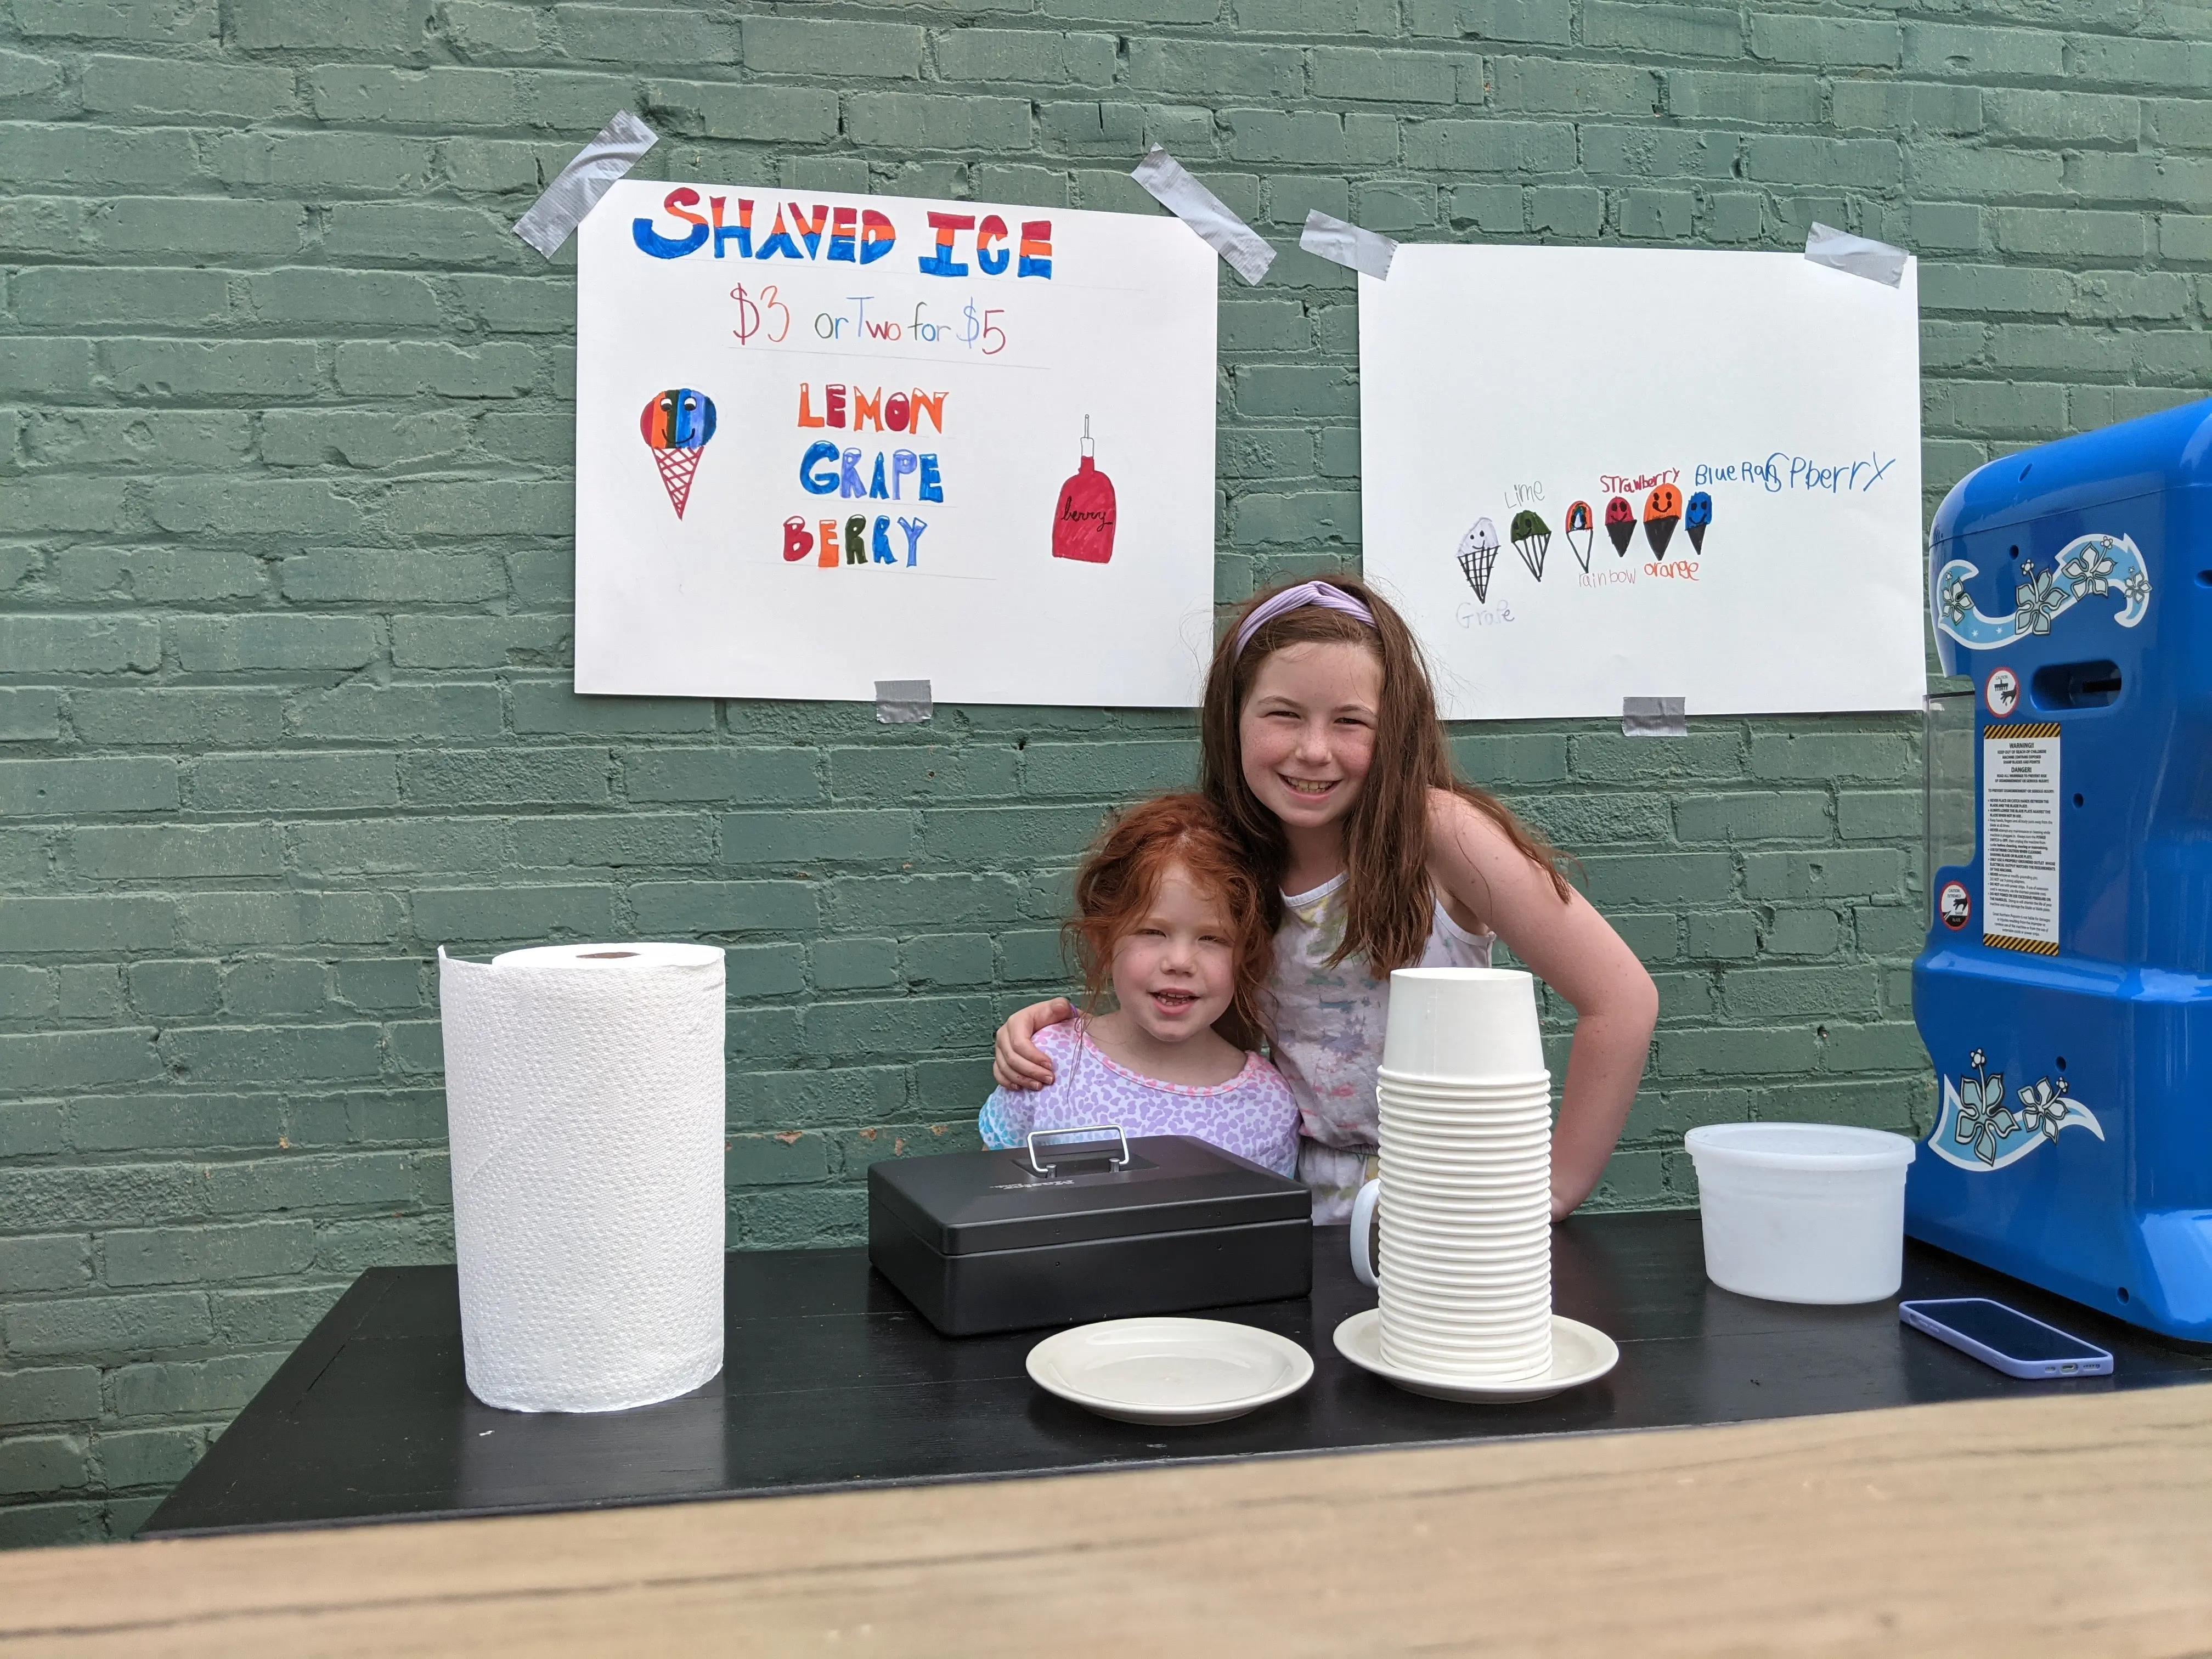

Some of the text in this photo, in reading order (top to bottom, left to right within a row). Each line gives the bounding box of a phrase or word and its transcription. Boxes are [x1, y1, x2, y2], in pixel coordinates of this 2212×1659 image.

[633, 187, 1052, 280] SHAVED ICE
[730, 282, 1006, 354] $3 or Two for $5
[798, 383, 949, 435] LEMON
[800, 440, 944, 503] GRAPE
[1695, 464, 1738, 486] Blue
[1061, 495, 1113, 532] berry
[1504, 481, 1545, 509] Lime
[783, 514, 928, 568] BERRY
[1578, 568, 1636, 588] rainbow
[1644, 560, 1700, 581] orange
